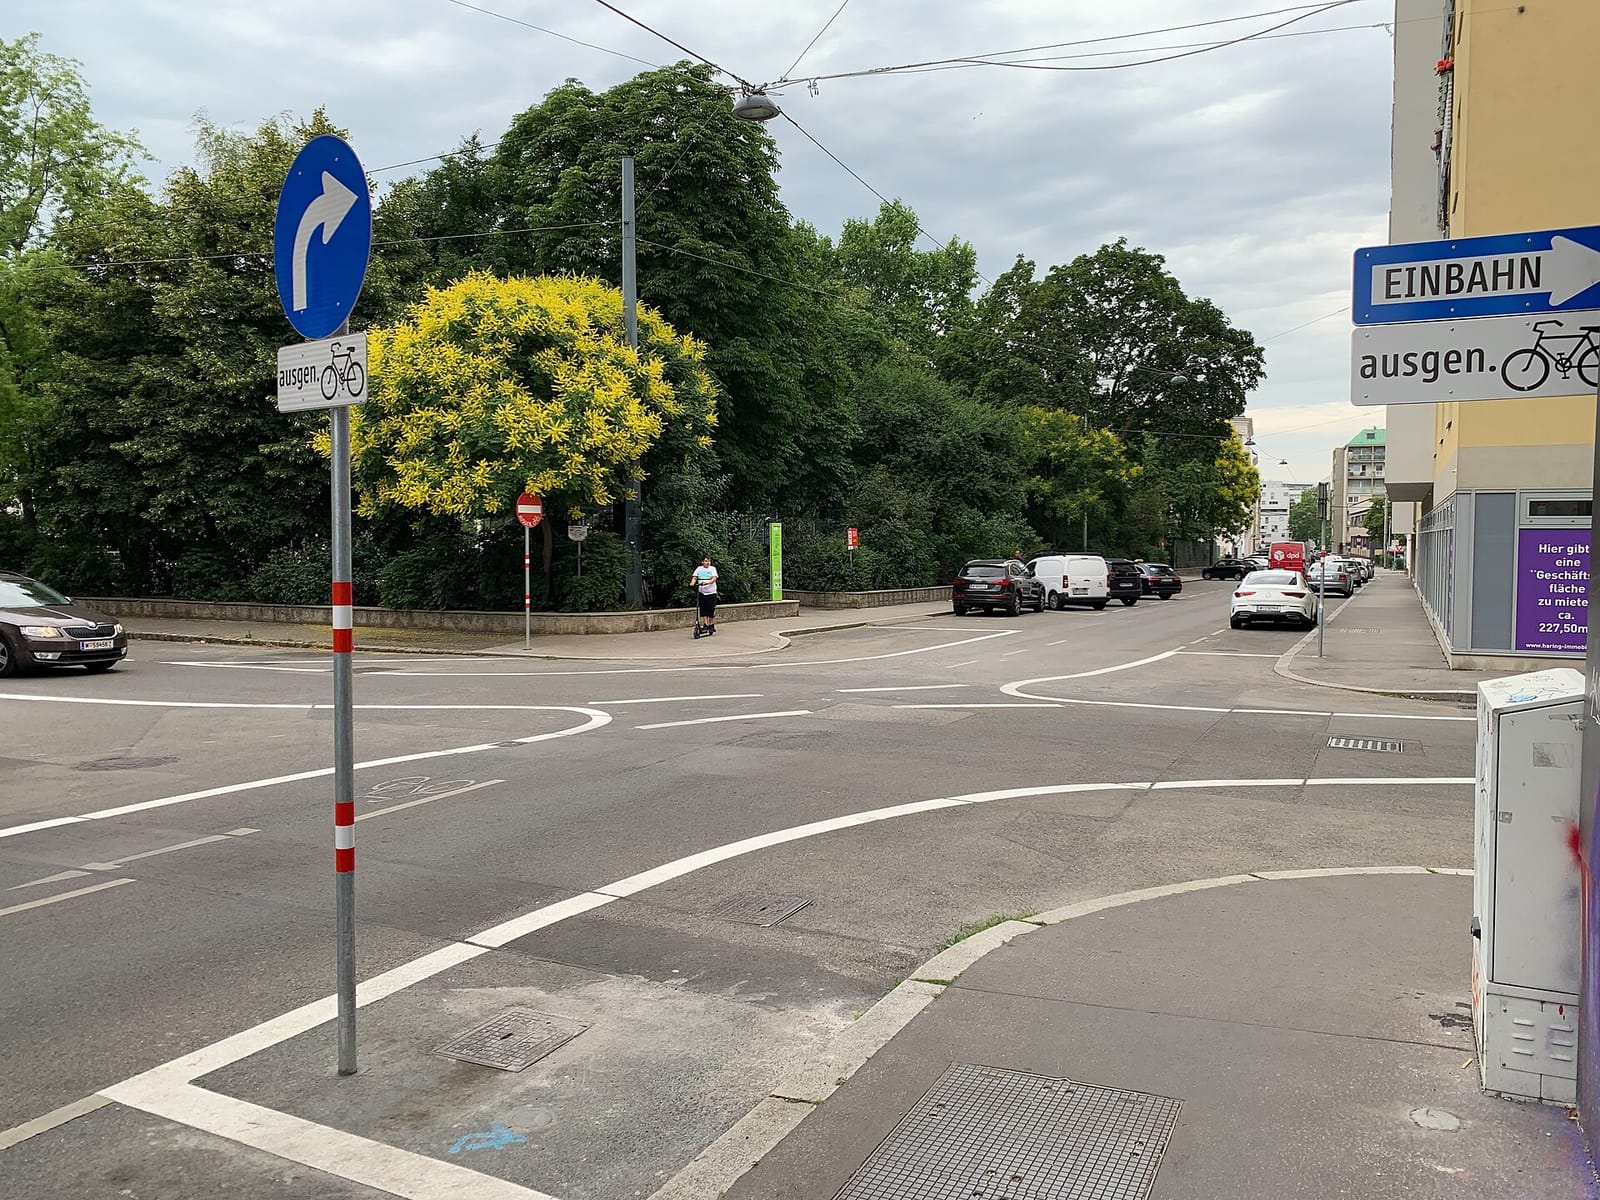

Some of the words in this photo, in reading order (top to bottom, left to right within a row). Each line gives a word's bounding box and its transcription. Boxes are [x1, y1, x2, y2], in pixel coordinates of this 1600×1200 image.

[1385, 255, 1541, 299] EINBAHN
[1360, 347, 1497, 383] ausgen.
[279, 365, 320, 390] ausgen.
[1538, 543, 1564, 554] Hier
[1286, 551, 1300, 560] dpd
[1555, 557, 1581, 567] eine
[1549, 583, 1586, 593] fläche
[1538, 598, 1551, 606] zu
[1558, 612, 1575, 620] ca.
